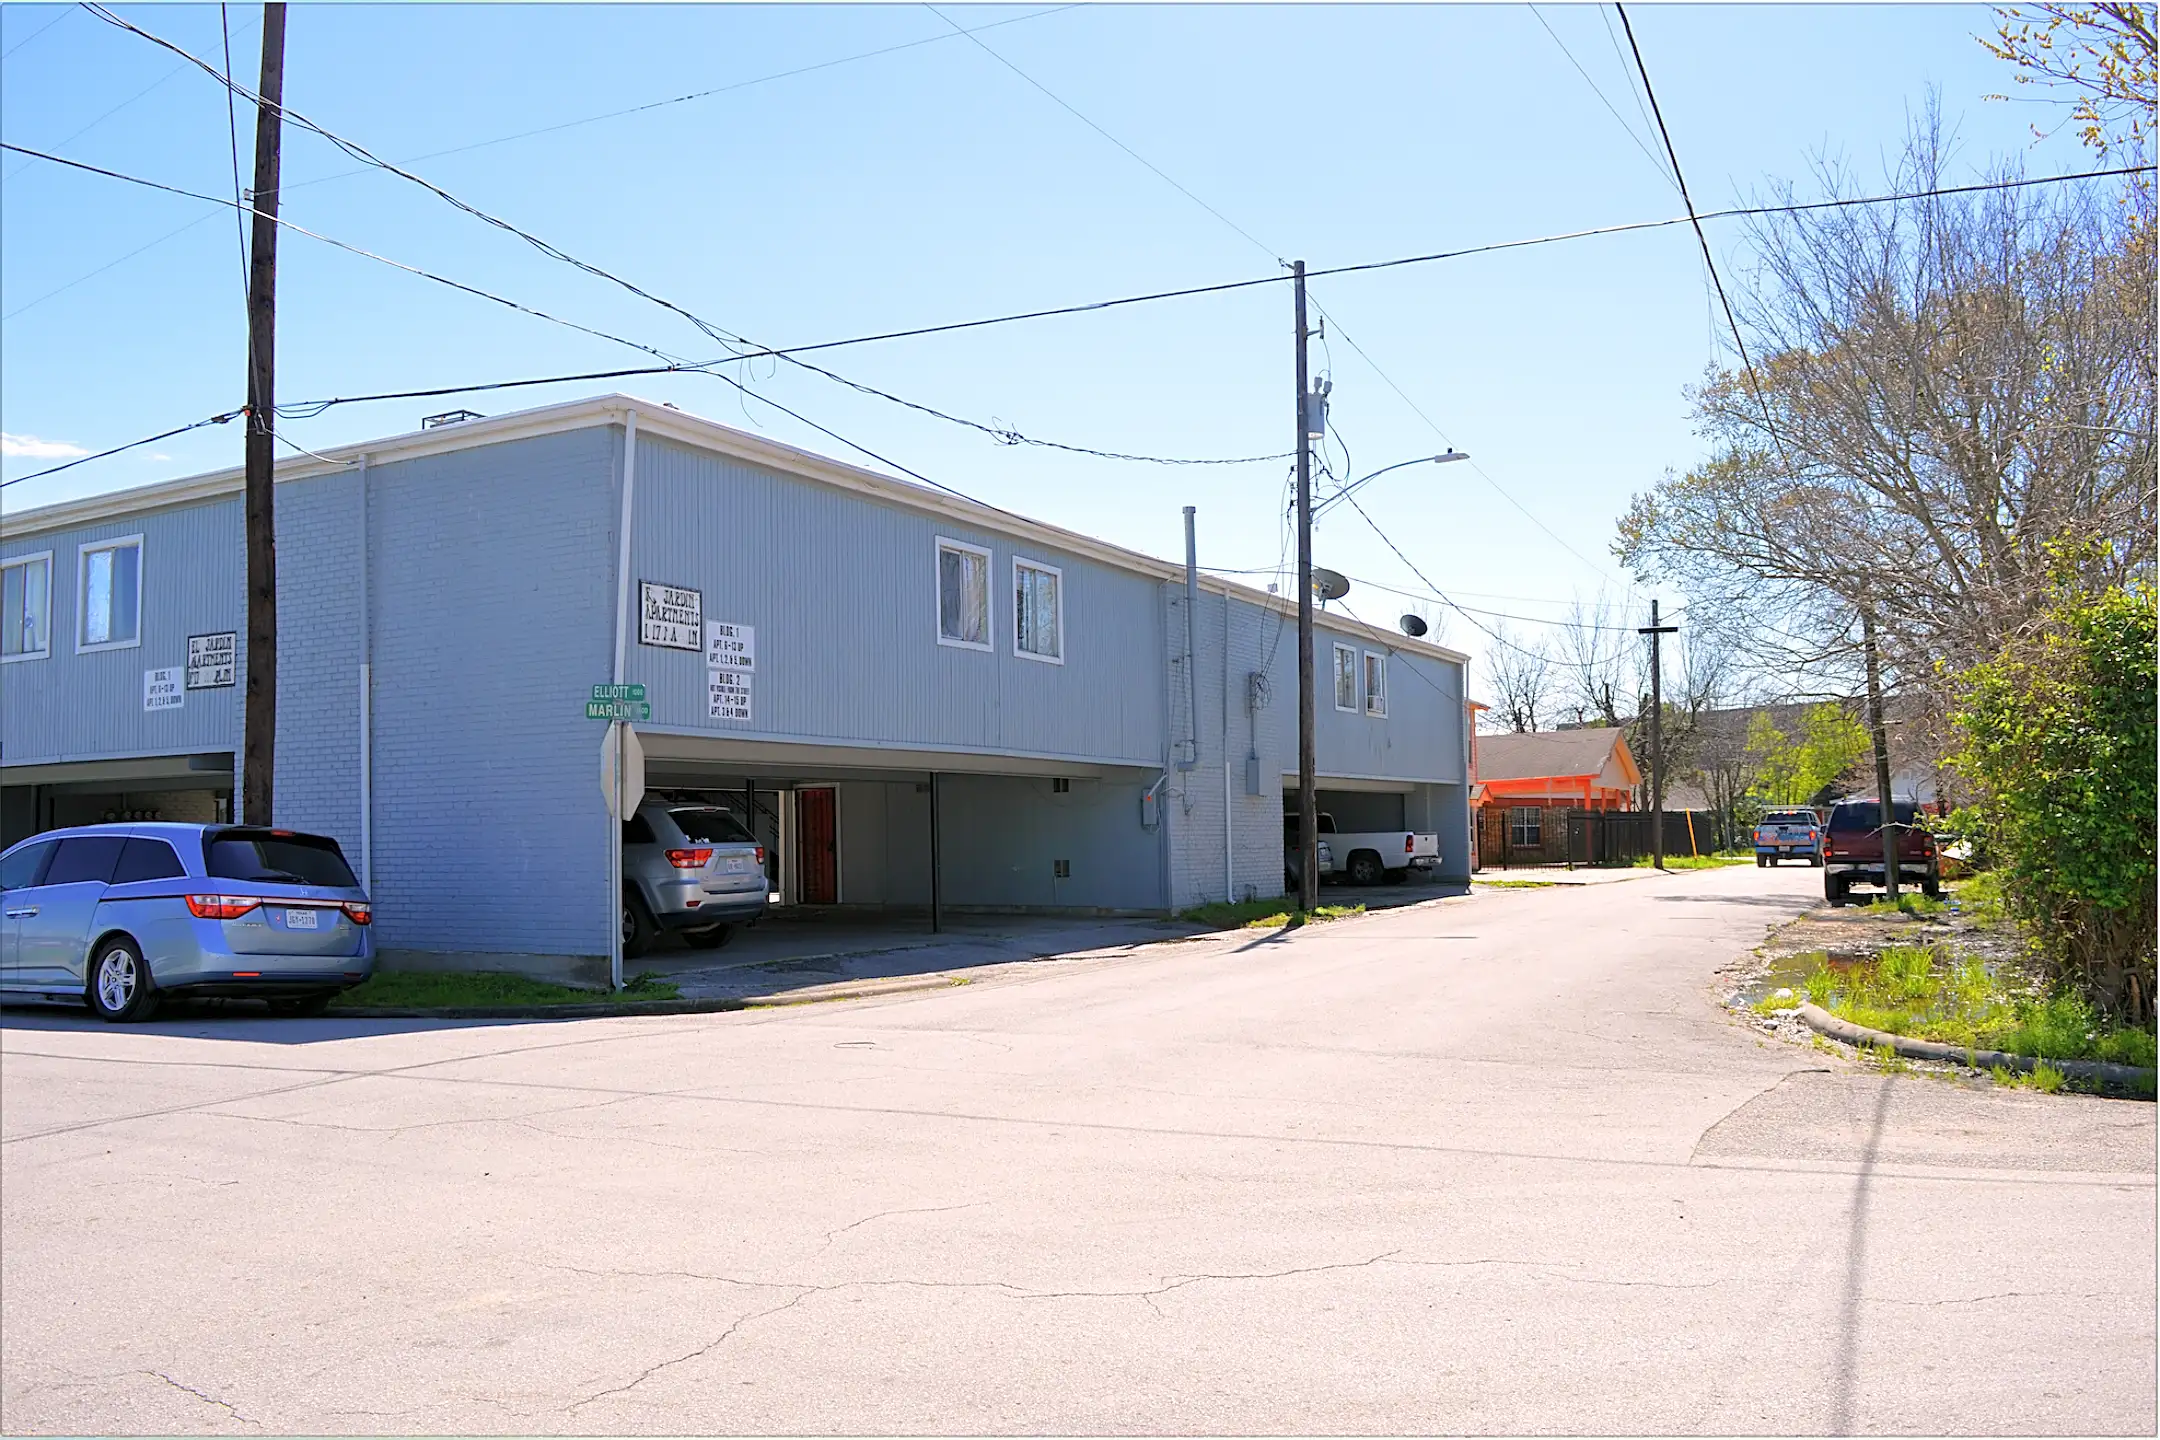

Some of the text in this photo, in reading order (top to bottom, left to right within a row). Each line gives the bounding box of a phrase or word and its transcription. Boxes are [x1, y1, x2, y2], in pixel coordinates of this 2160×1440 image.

[663, 589, 695, 609] JARDIN
[645, 604, 699, 627] APARTMENTS
[736, 674, 741, 686] 2
[594, 685, 629, 699] ELLIOTT
[588, 703, 631, 718] MARLIN
